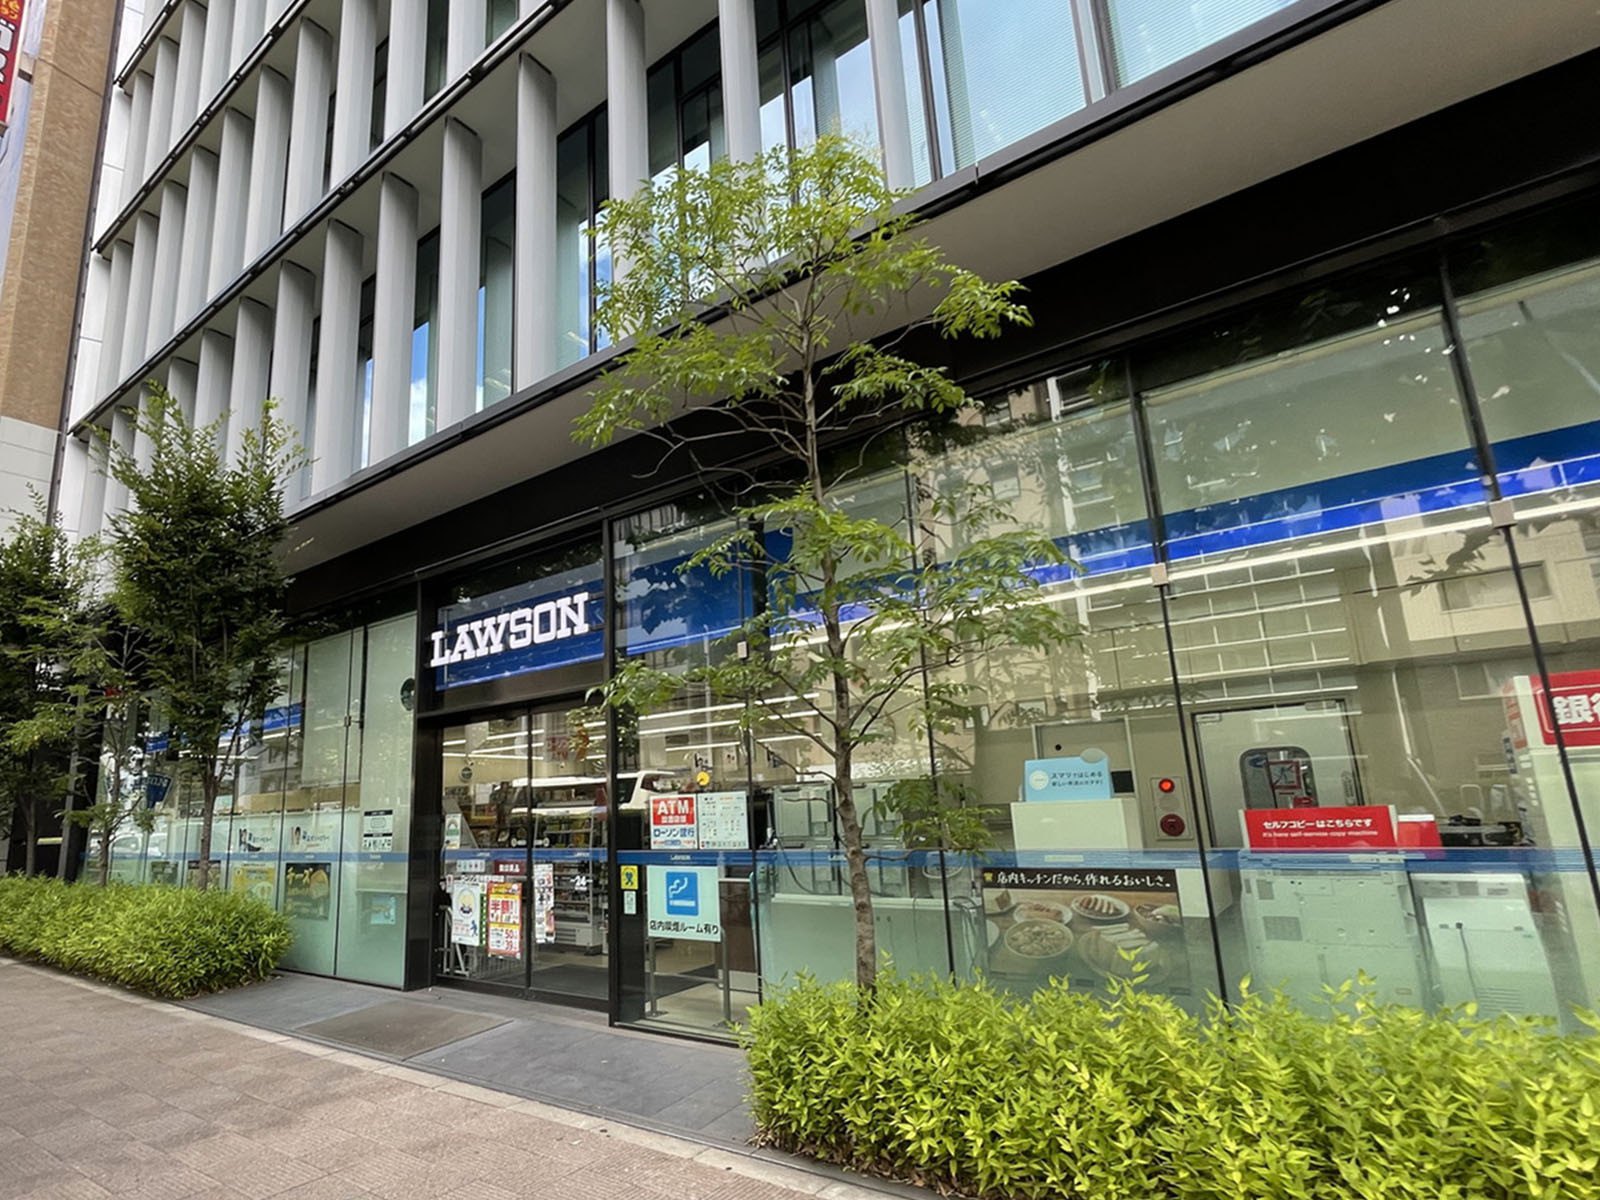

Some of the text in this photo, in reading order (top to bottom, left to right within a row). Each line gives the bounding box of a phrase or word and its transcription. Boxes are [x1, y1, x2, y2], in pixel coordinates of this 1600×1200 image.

[430, 591, 589, 667] LAWSON
[657, 800, 689, 815] ATM
[1263, 818, 1373, 829] セルフコピーはこちらです
[649, 920, 720, 935] 店内喫煙ルーム有り
